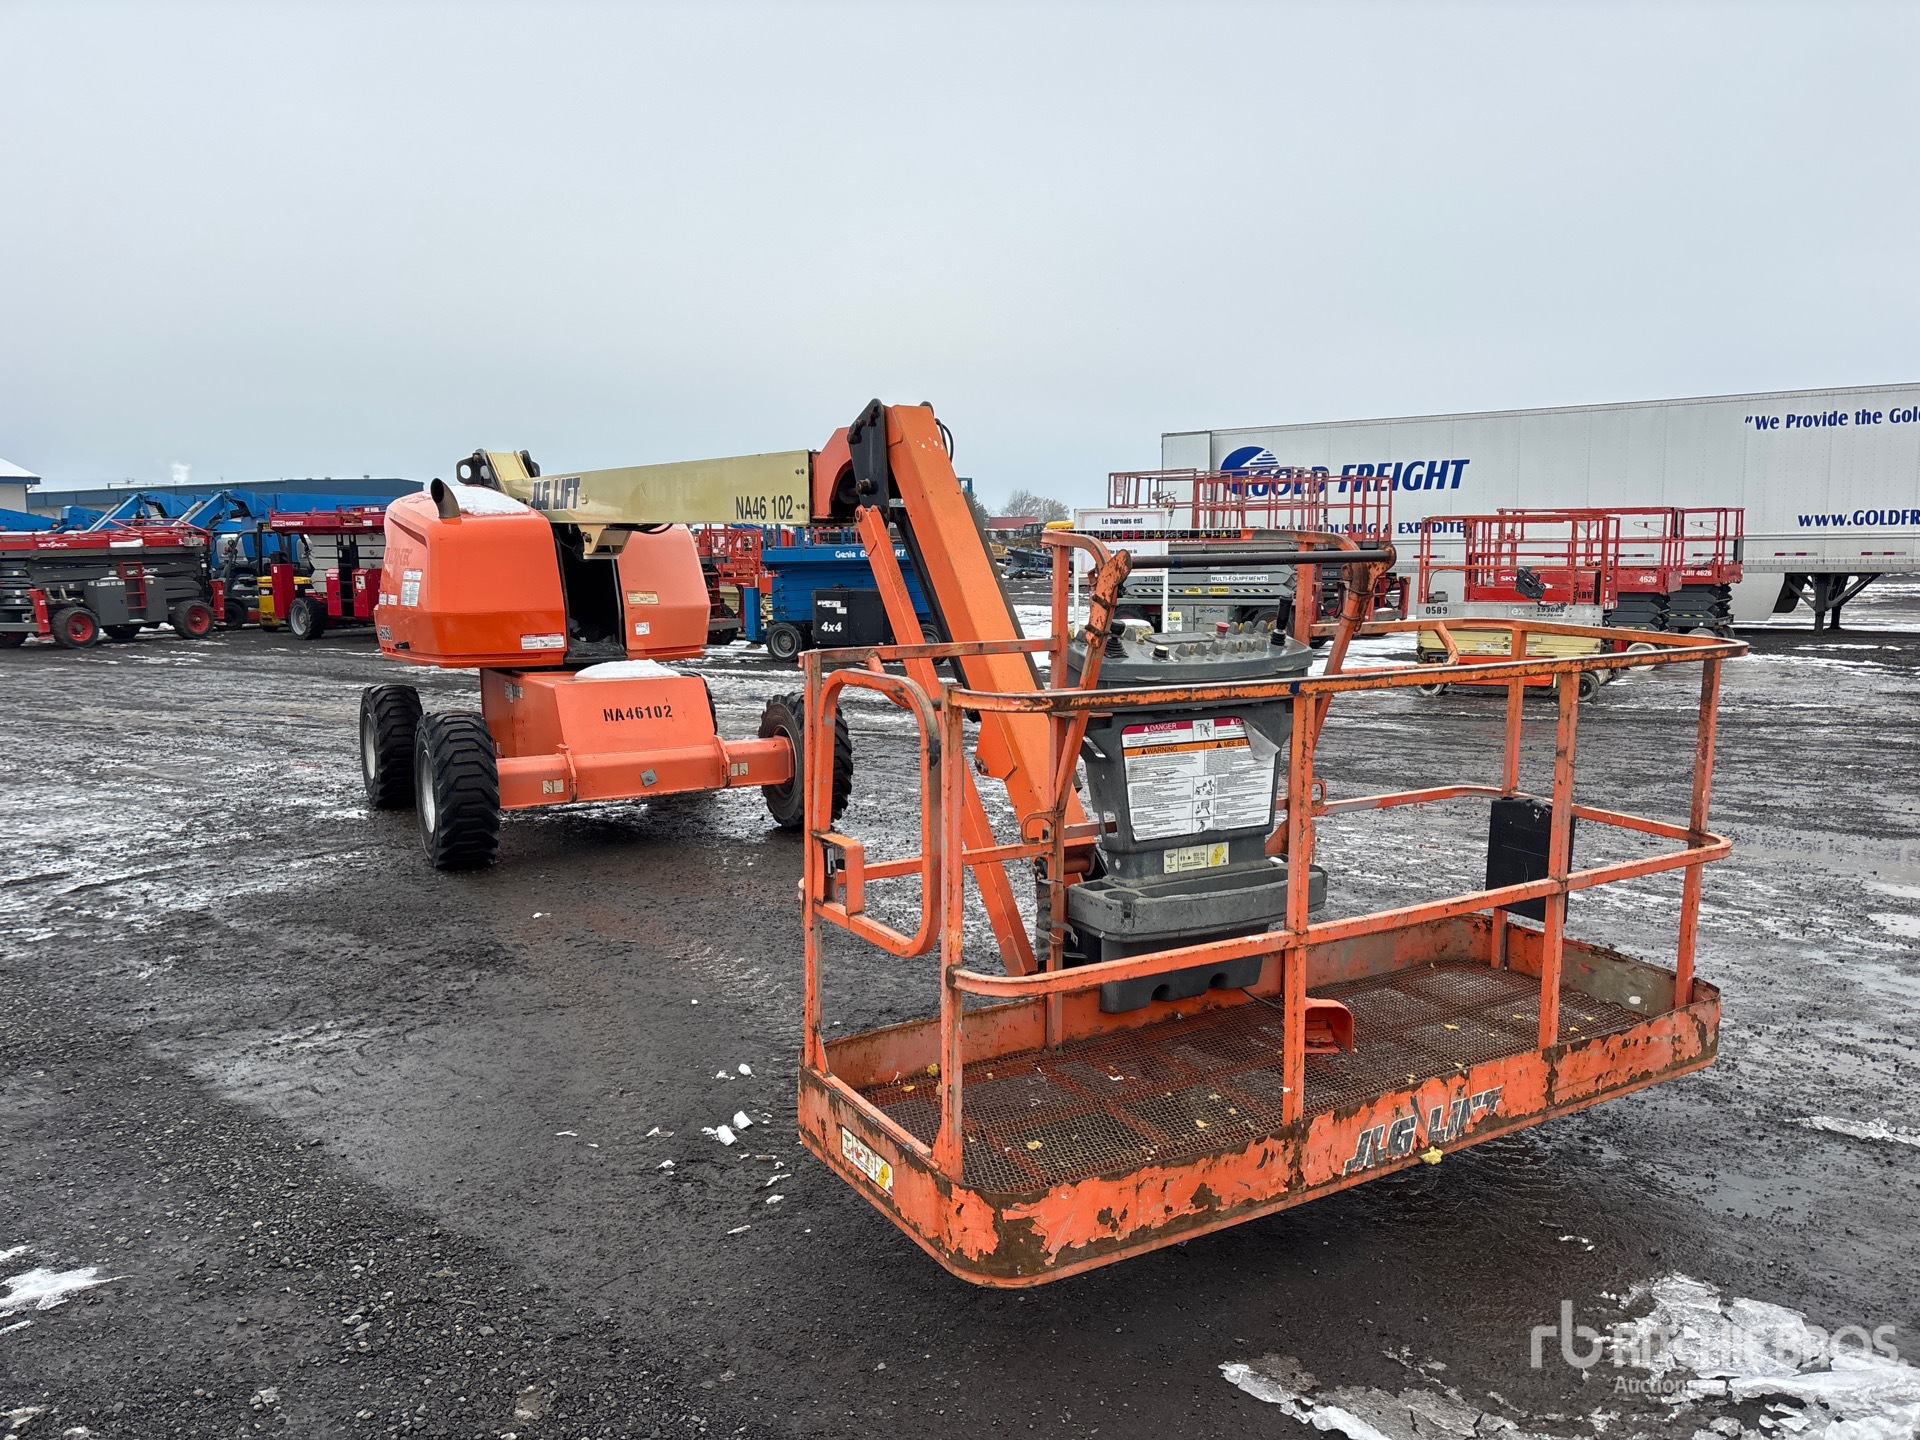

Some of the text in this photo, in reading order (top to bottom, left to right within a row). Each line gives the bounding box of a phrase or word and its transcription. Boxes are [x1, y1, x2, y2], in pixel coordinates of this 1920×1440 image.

[1786, 410, 1849, 429] Provide
[1855, 409, 1883, 425] the
[1889, 406, 1920, 424] Gol
[1338, 459, 1471, 493] FREIGHT
[530, 476, 581, 511] JLG LIFT
[735, 494, 794, 520] NA46 102
[1101, 517, 1109, 525] Le
[1110, 517, 1132, 525] harnais
[835, 550, 857, 559] Genie
[1639, 575, 1657, 584] 4626
[820, 621, 843, 633] 4x4
[603, 704, 673, 723] NA46102
[1150, 722, 1178, 732] DANGER
[1146, 745, 1178, 754] WARNING
